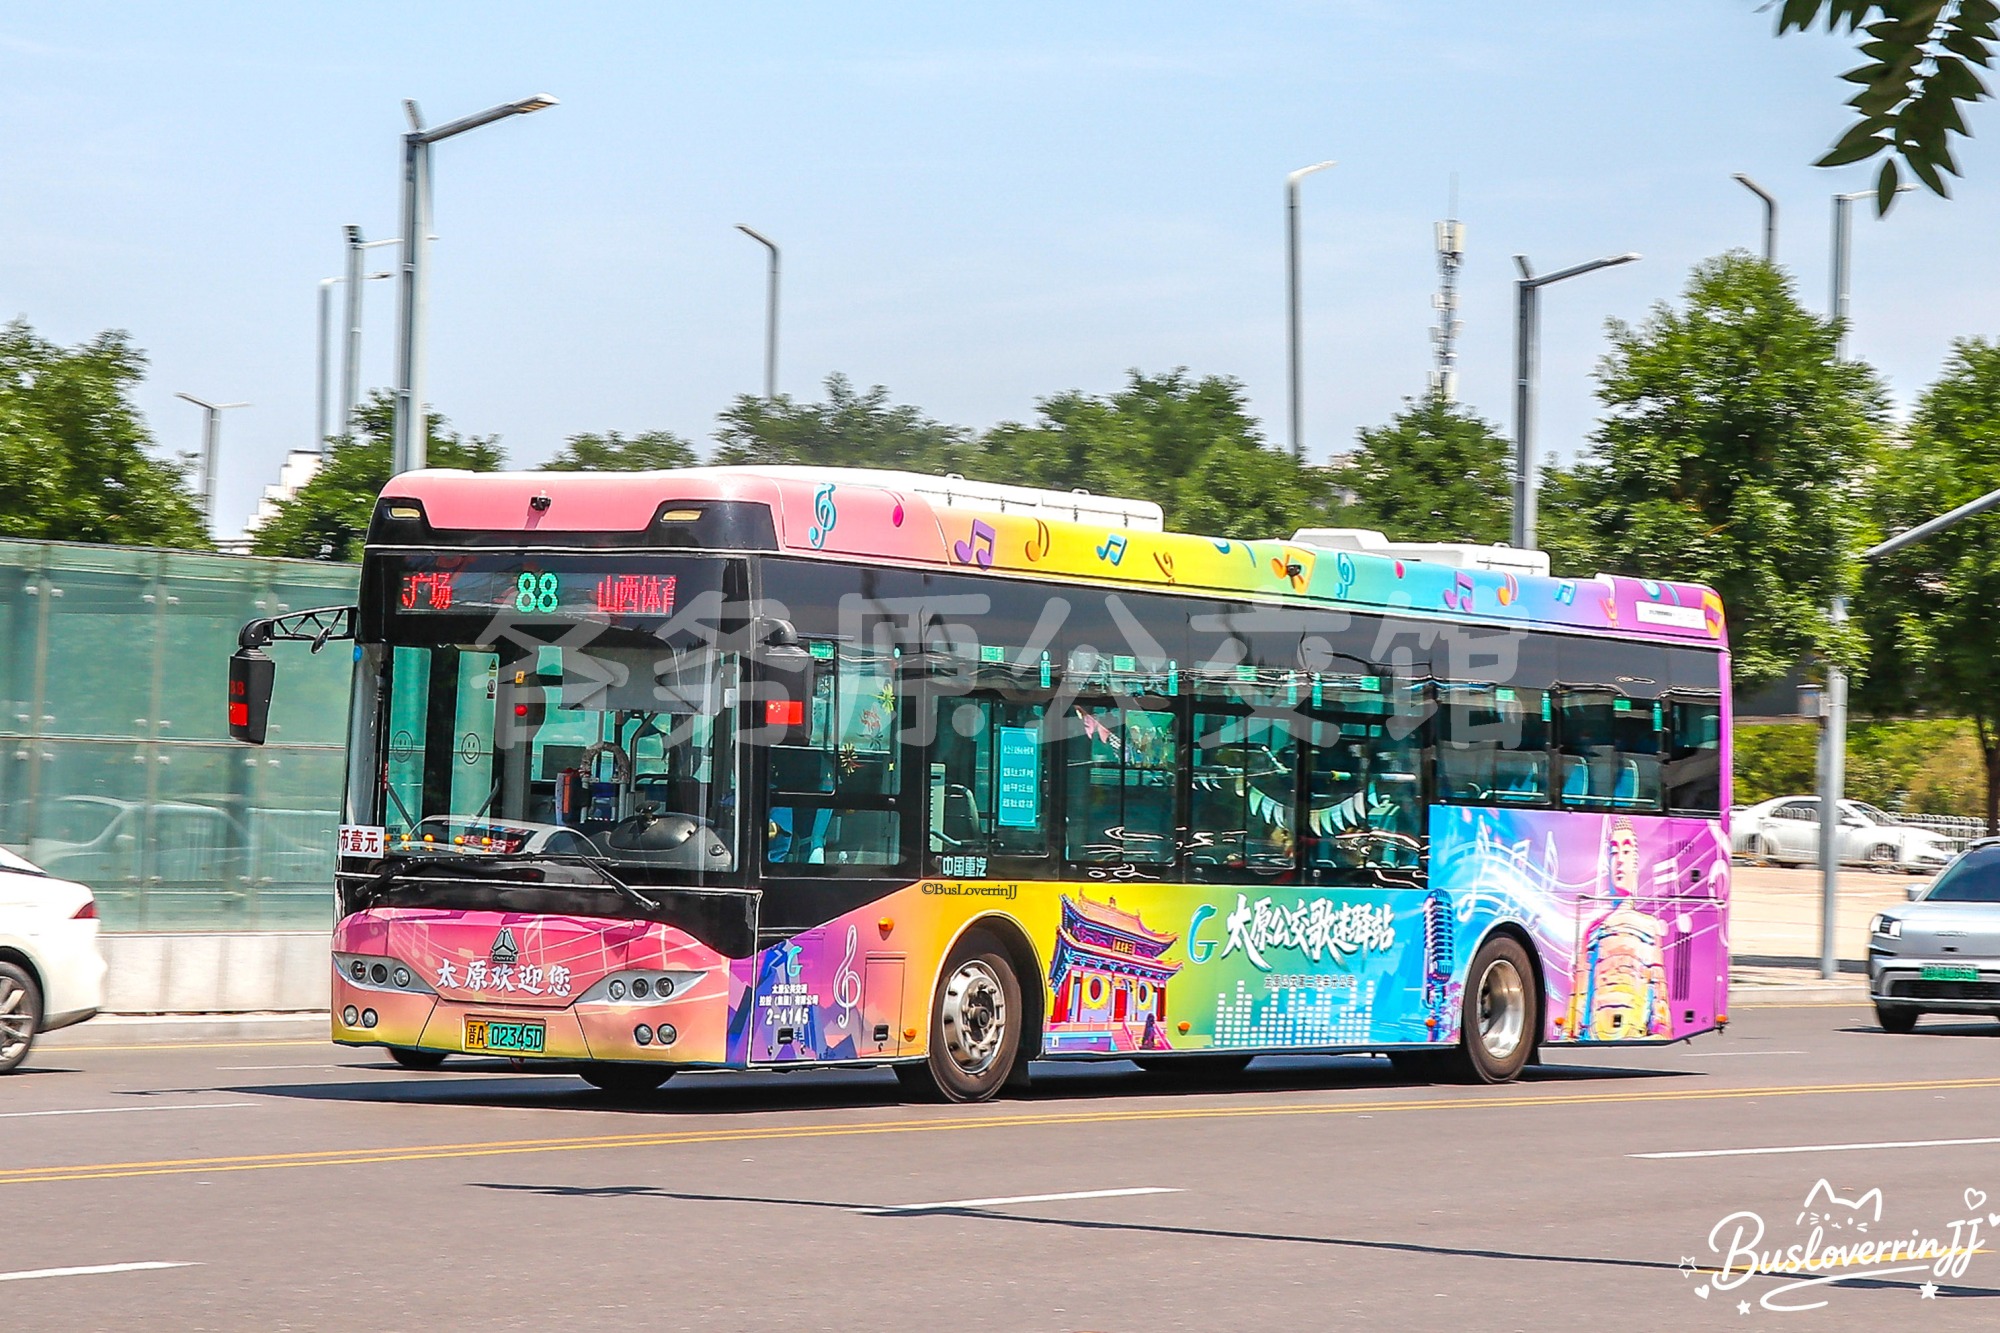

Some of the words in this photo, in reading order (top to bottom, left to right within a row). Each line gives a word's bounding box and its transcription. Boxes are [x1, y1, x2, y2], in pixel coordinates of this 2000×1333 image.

[402, 572, 452, 610] 广场
[516, 572, 559, 613] 88
[941, 856, 988, 877] 中国重汽
[435, 957, 571, 997] 太原欢迎您
[766, 1008, 810, 1025] 2-4145
